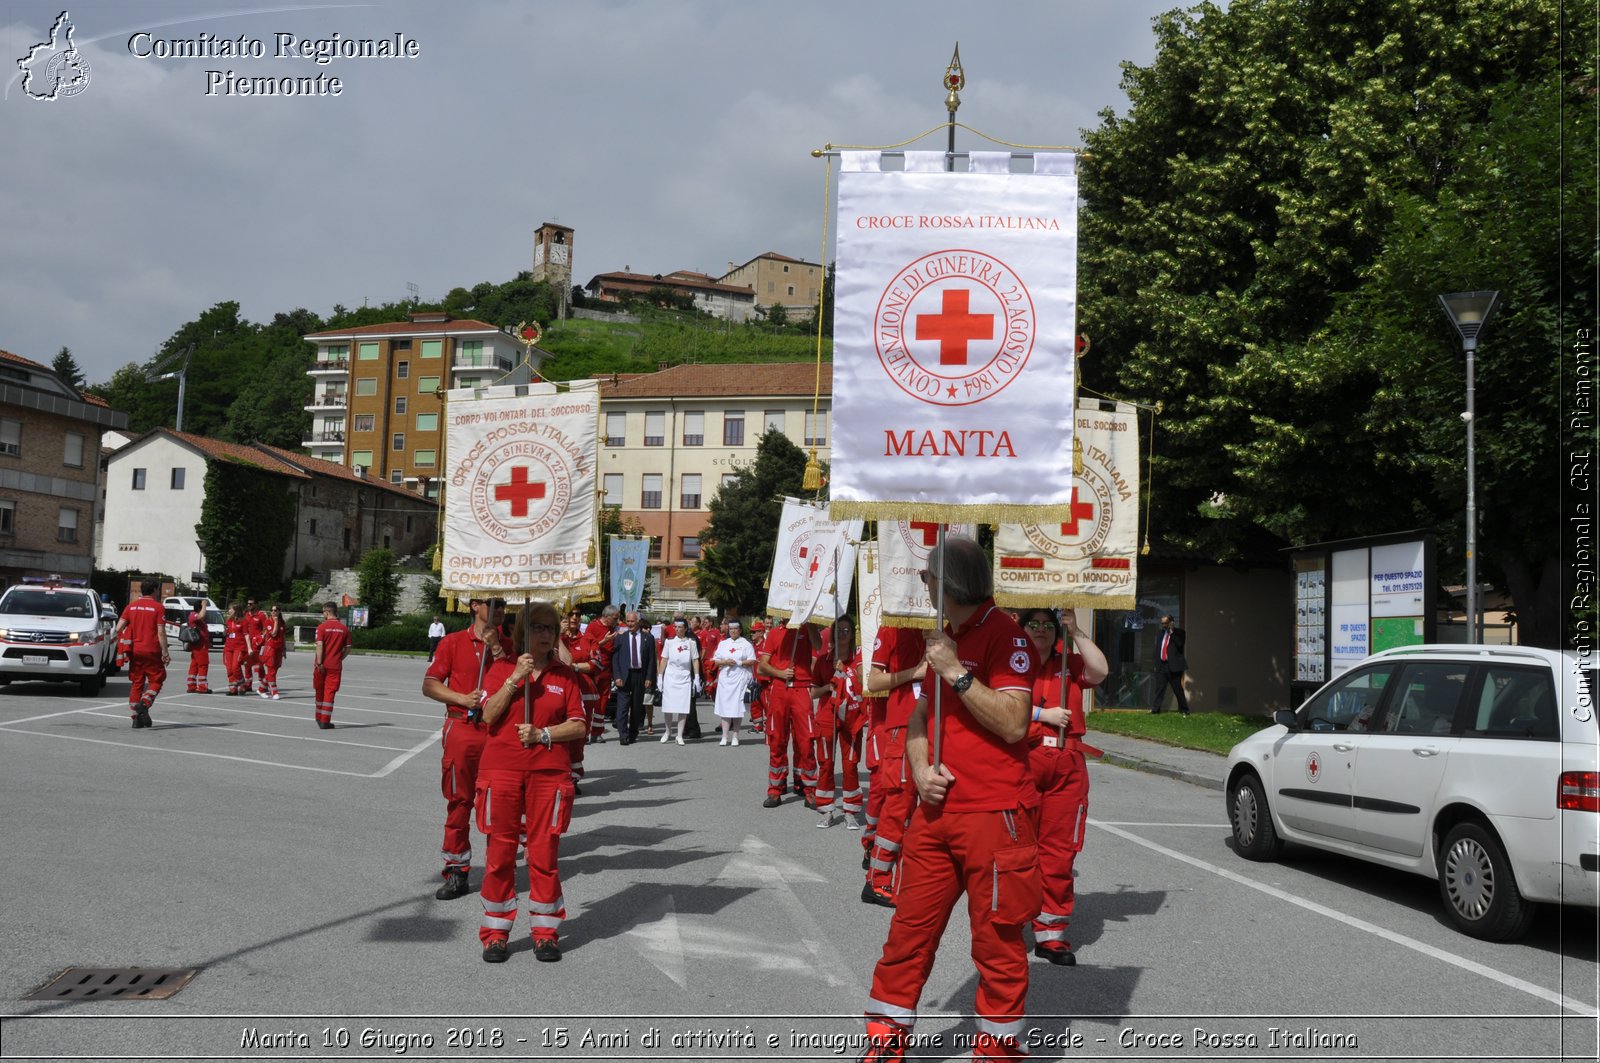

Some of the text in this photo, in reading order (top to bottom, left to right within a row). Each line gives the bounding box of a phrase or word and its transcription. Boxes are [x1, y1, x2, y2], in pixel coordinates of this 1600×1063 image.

[856, 216, 1060, 230] CROCE ROSSA ITALIANA
[881, 256, 1028, 398] CONVENZIONE DI GINEVRA 22 AGOSTO 1864
[456, 414, 480, 426] CORPO
[551, 404, 591, 417] SOCCORSO
[1077, 418, 1128, 432] DEL SOCCORSO
[504, 443, 550, 462] GINEVRA
[884, 430, 1018, 458] MANTA
[453, 422, 590, 487] CROCE ROSSA ITALIANA
[488, 455, 499, 468] DI
[551, 460, 564, 474] 22
[1087, 445, 1132, 502] ITALIANA
[474, 471, 508, 538] CONVENZIONE
[551, 476, 570, 516] AGOSTO
[448, 555, 512, 570] GRUPPO
[518, 554, 532, 567] DI
[449, 569, 588, 585] COMITATO LOCALE
[1001, 572, 1062, 583] COMITATO
[1066, 573, 1078, 583] DI
